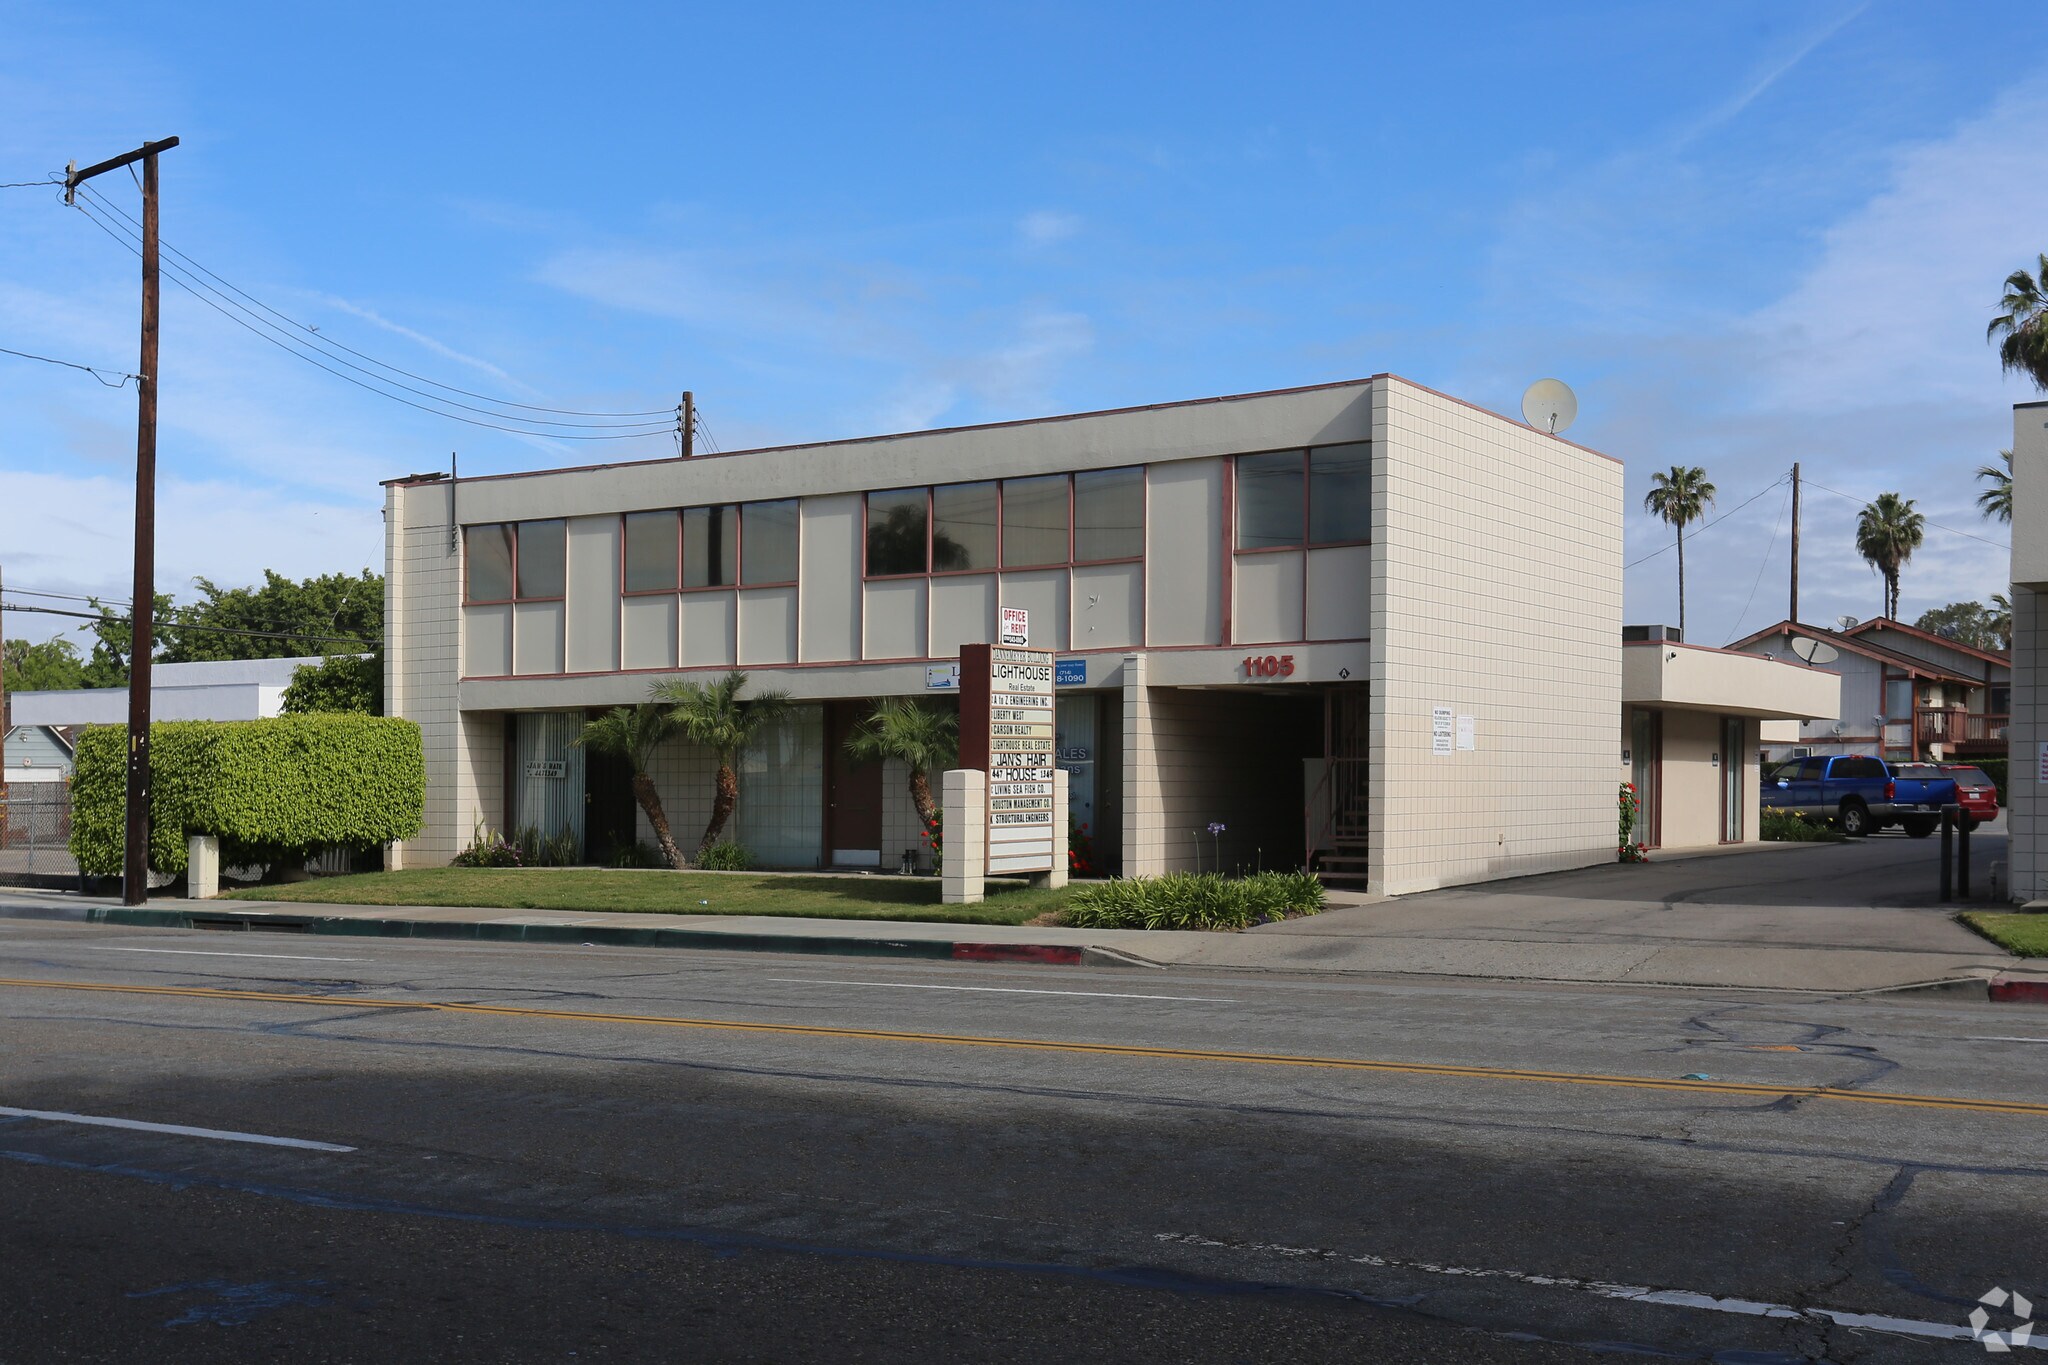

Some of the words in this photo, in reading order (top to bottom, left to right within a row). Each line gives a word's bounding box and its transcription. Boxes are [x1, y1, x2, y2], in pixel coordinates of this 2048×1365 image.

[1004, 610, 1026, 622] OFFICE
[1011, 623, 1026, 634] RENT
[1243, 655, 1295, 677] 1105
[992, 664, 1050, 681] LIGHTHOUSE
[1020, 683, 1035, 691] Estate
[994, 695, 998, 704] A
[999, 695, 1004, 705] to
[1005, 695, 1009, 705] Z
[1010, 696, 1039, 706] ENGINEERING
[1040, 697, 1049, 706] INC.
[994, 710, 1011, 720] LIBERTY
[1013, 711, 1024, 720] WEST
[994, 725, 1013, 735] CARSON
[1015, 725, 1032, 735] REALTY
[993, 740, 1021, 750] LIGHTHOUSE
[1022, 740, 1034, 750] REAL
[1035, 740, 1051, 750] ESTATE
[1056, 748, 1086, 759] ALES
[997, 753, 1022, 766] JAN'S
[1027, 753, 1047, 766] HAIR
[992, 769, 1003, 779] 447
[1005, 768, 1037, 781] HOUSE
[995, 784, 1012, 795] LIVING
[1013, 784, 1023, 794] SEA
[1025, 784, 1036, 794] FISH
[1037, 784, 1046, 794] CO.
[992, 800, 1013, 809] HOUSTON
[1014, 799, 1043, 809] MANAGEMENT
[996, 814, 1025, 824] STRUCTURAL
[1025, 813, 1050, 823] ENGINEERS
